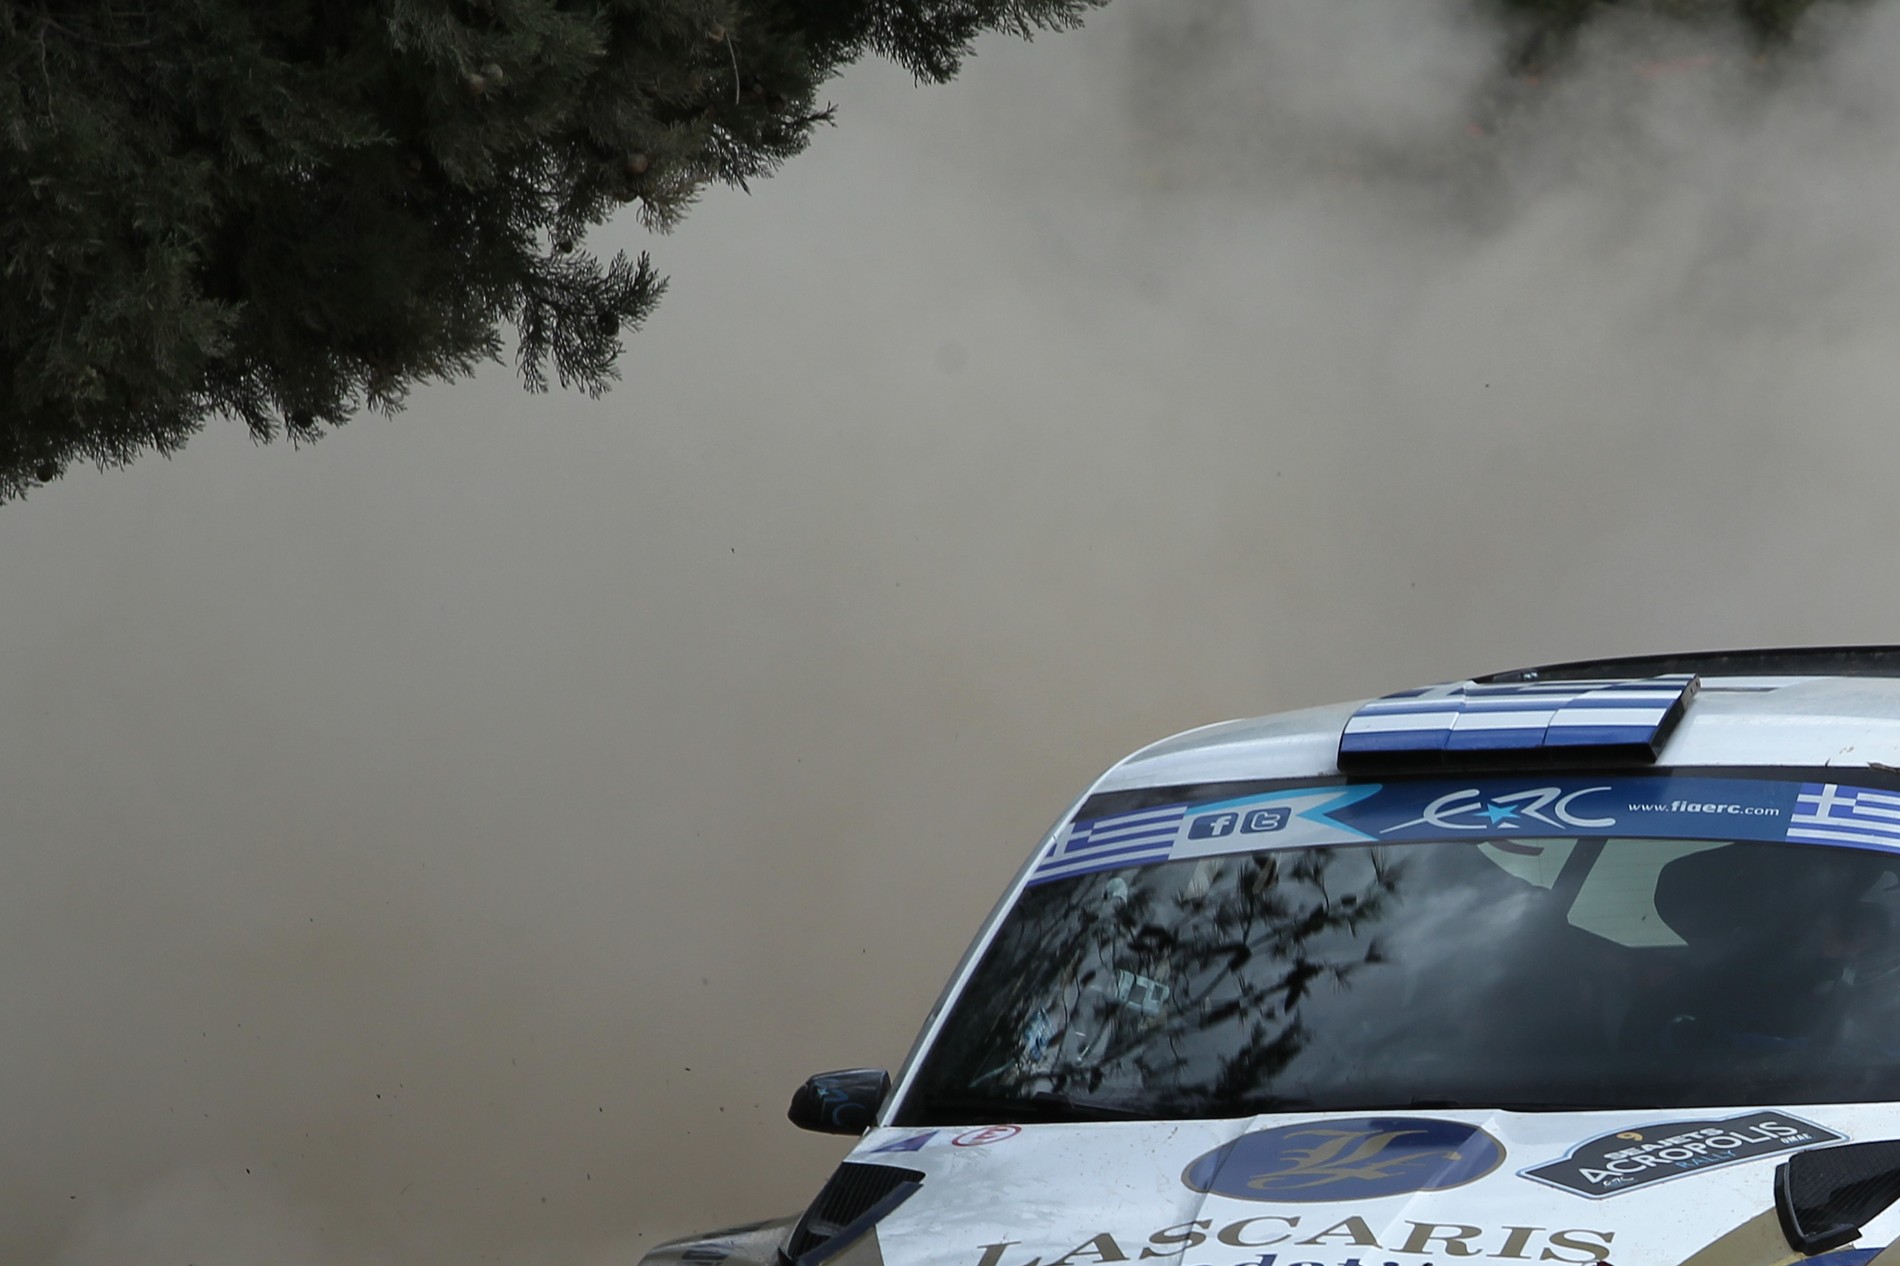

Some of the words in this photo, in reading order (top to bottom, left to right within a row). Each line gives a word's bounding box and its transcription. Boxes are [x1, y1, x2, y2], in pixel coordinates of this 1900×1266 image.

[1628, 800, 1780, 817] www.fiaerc.com
[1578, 1121, 1798, 1185] ACROPOLIS
[1604, 1127, 1725, 1160] SEAJETS
[1674, 1150, 1736, 1168] RALLY
